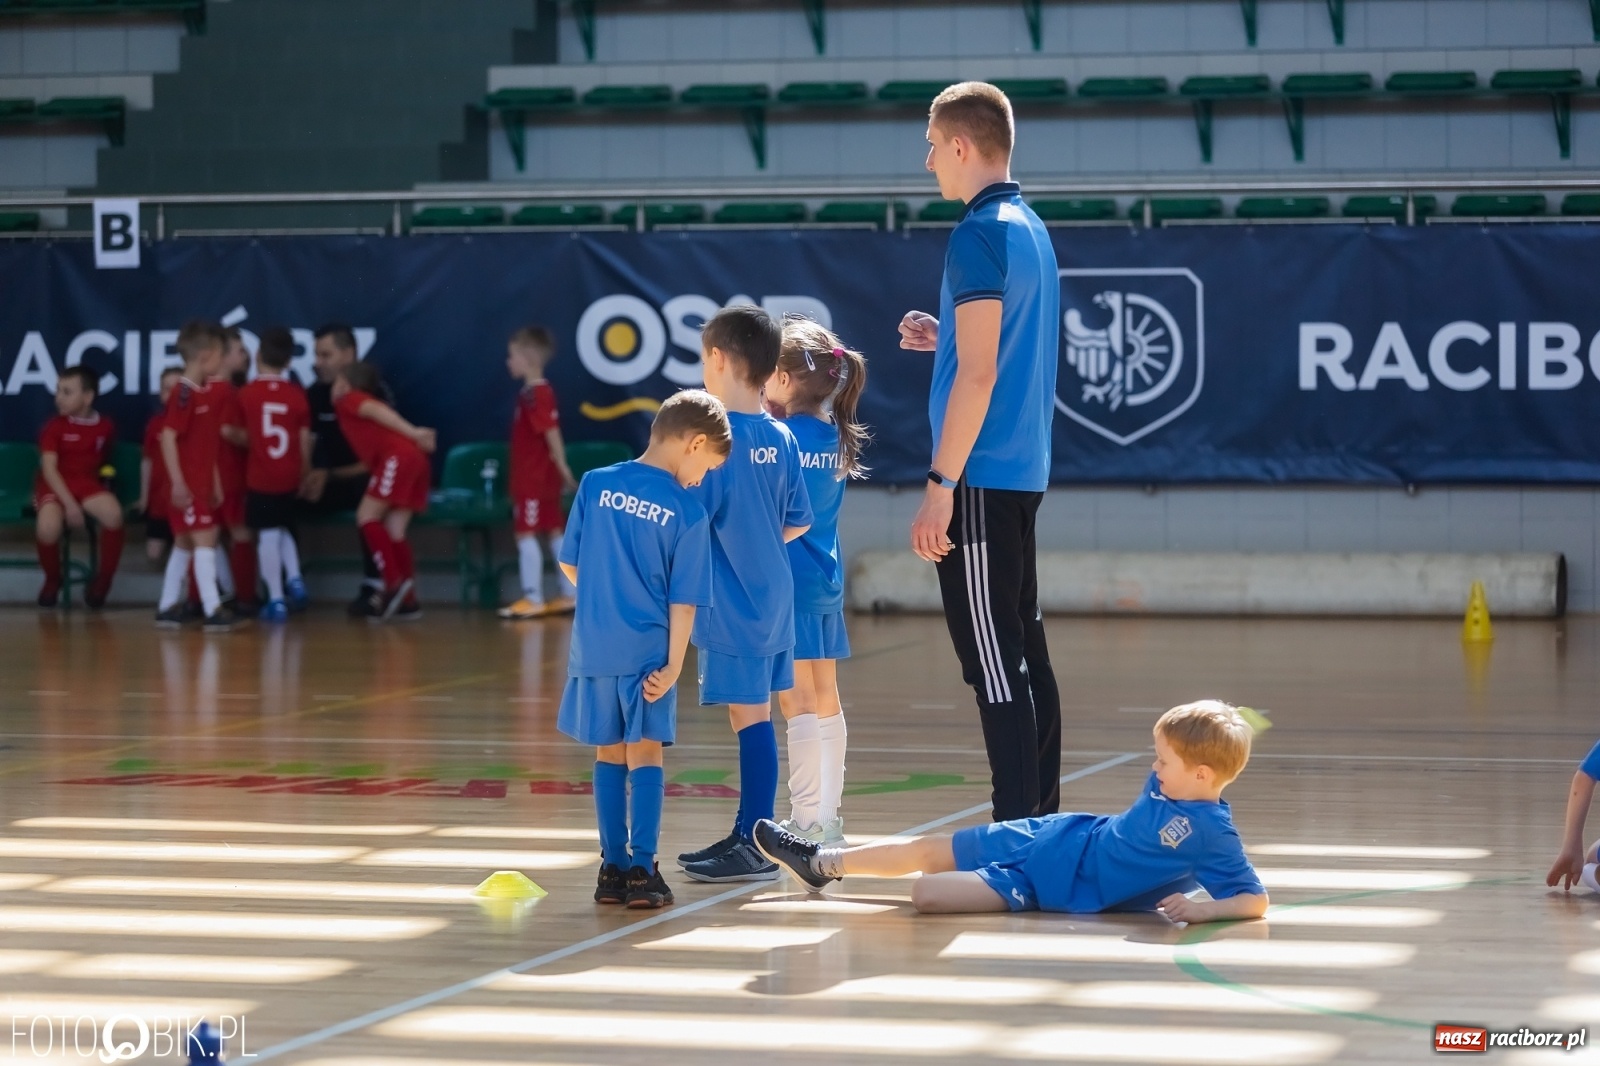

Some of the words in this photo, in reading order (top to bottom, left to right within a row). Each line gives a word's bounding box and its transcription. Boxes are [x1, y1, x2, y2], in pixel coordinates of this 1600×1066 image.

[101, 213, 133, 252] B
[576, 294, 832, 386] OS
[1299, 321, 1600, 391] RACIB
[262, 402, 289, 460] 5
[599, 489, 675, 527] ROBERT
